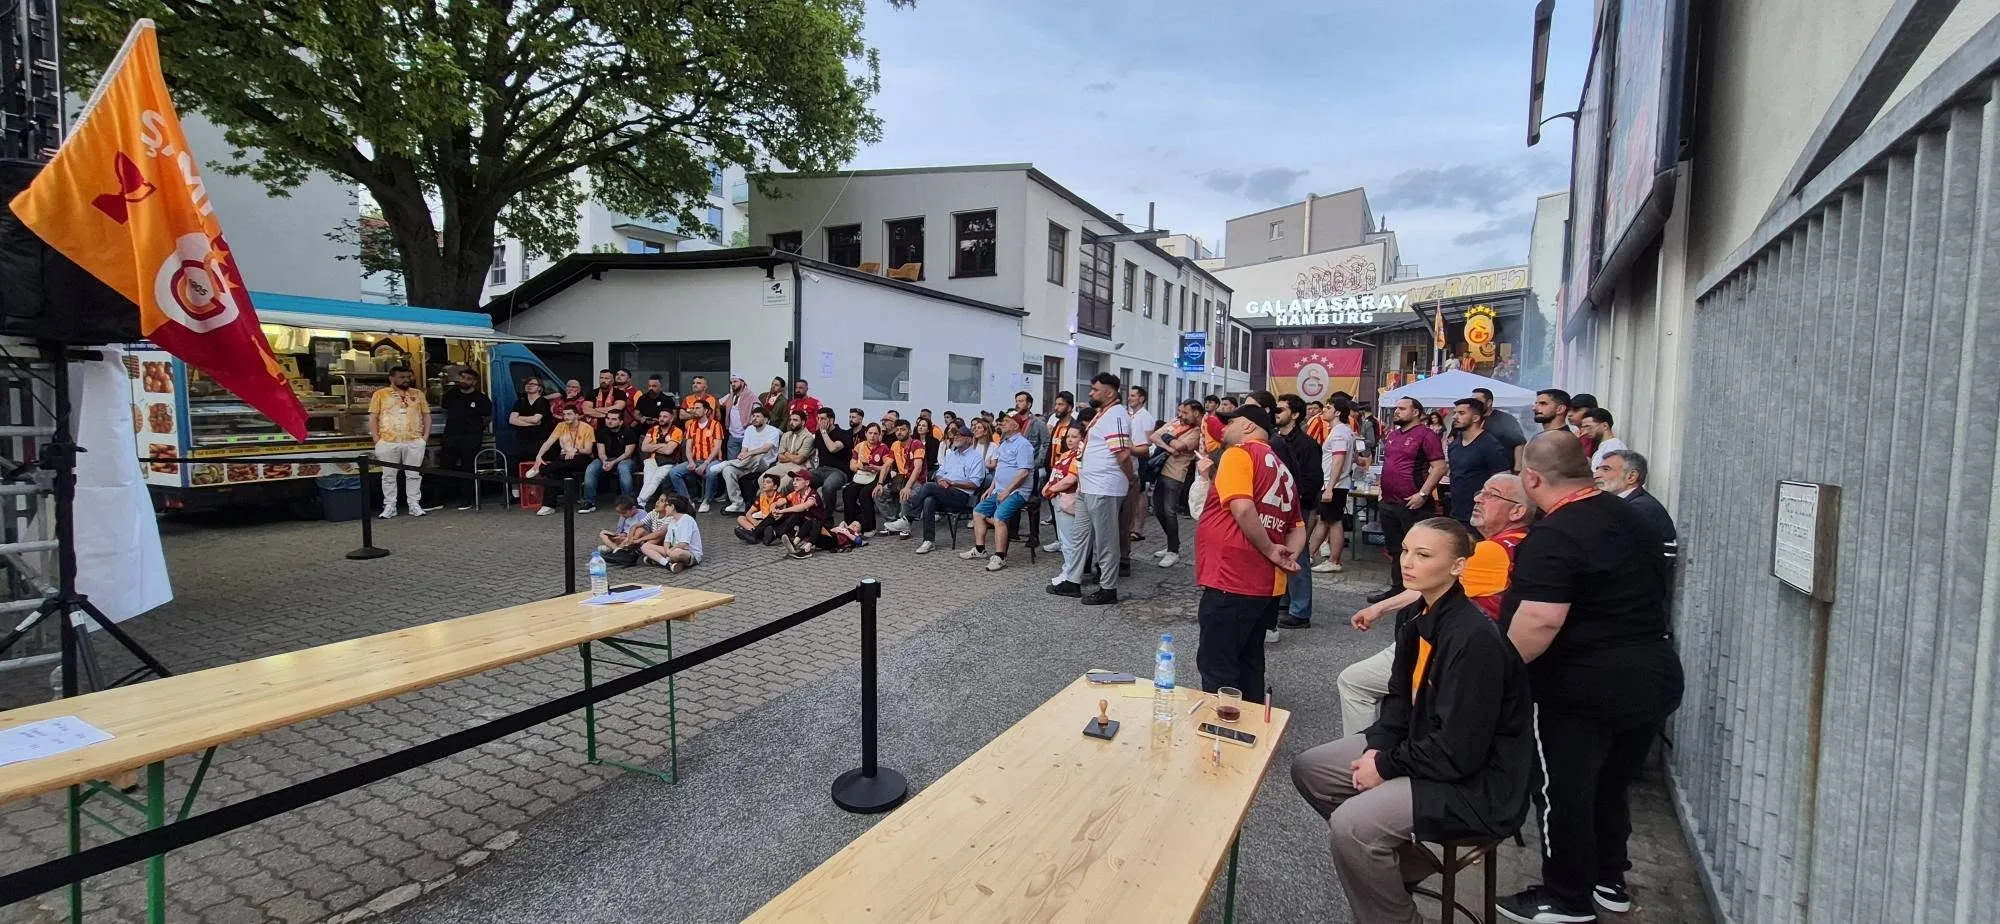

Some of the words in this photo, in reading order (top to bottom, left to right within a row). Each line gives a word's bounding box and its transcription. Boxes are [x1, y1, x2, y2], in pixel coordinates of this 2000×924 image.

[1246, 295, 1407, 315] GALATASARAY
[1276, 311, 1374, 326] HAMBURG
[1262, 453, 1294, 512] 23
